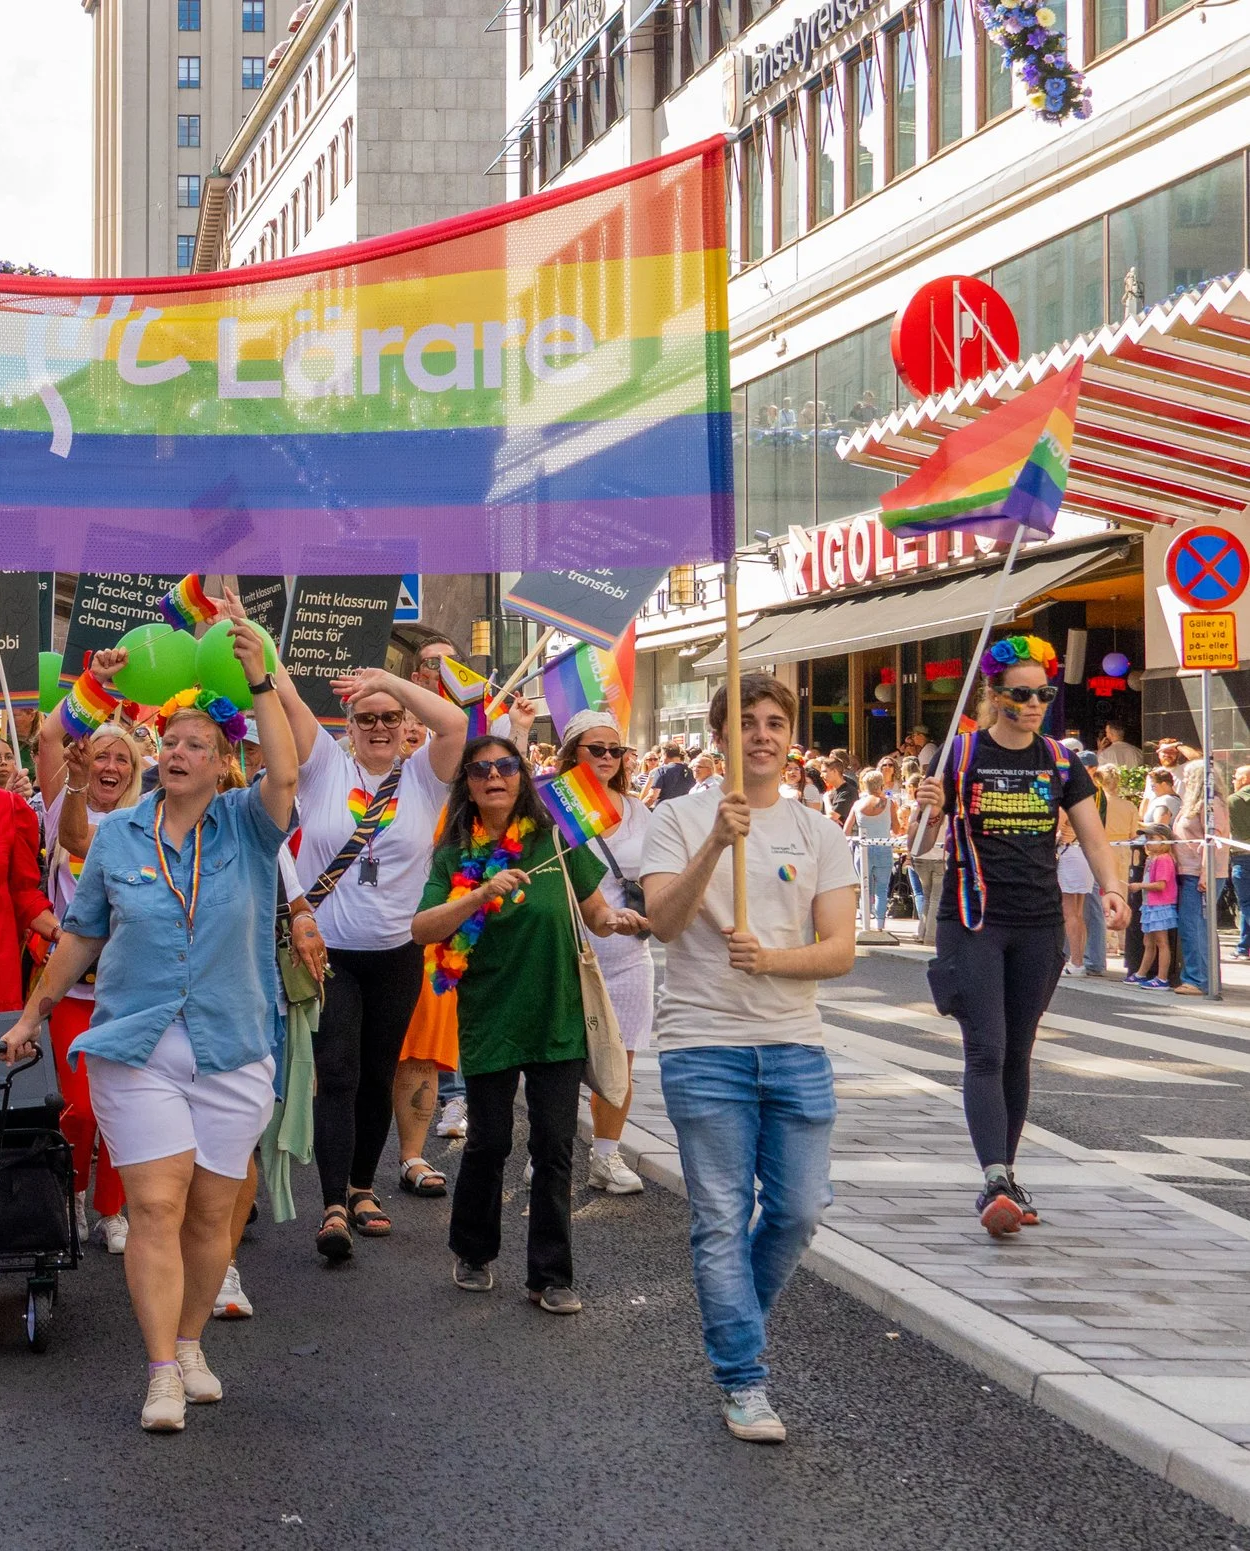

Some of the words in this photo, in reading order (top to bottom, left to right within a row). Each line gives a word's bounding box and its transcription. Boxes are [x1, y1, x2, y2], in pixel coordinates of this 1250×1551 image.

[218, 306, 596, 399] Lärare
[137, 573, 154, 590] bi,
[158, 578, 177, 590] tra
[567, 569, 630, 600] transfobi
[97, 582, 143, 602] facket
[145, 593, 162, 607] ge
[244, 592, 256, 604] mitt
[255, 583, 282, 600] klassrum
[299, 590, 304, 603] I
[305, 591, 332, 606] mitt
[332, 593, 388, 610] klassrum
[81, 597, 108, 612] alla
[109, 603, 165, 622] samma
[257, 600, 273, 612] ingen
[78, 613, 127, 631] chans!
[295, 608, 327, 623] finns
[327, 610, 363, 628] ingen
[1188, 620, 1216, 628] Gäller
[1218, 619, 1227, 629] ej
[291, 626, 323, 642] plats
[325, 628, 344, 642] för
[1191, 631, 1209, 639] taxi
[288, 643, 332, 662] homo-,
[334, 646, 352, 661] bi-
[1189, 642, 1206, 652] på-
[1208, 641, 1230, 649] eller
[1186, 653, 1233, 662] avstigning
[286, 661, 313, 676] eller
[551, 780, 573, 813] Lärare
